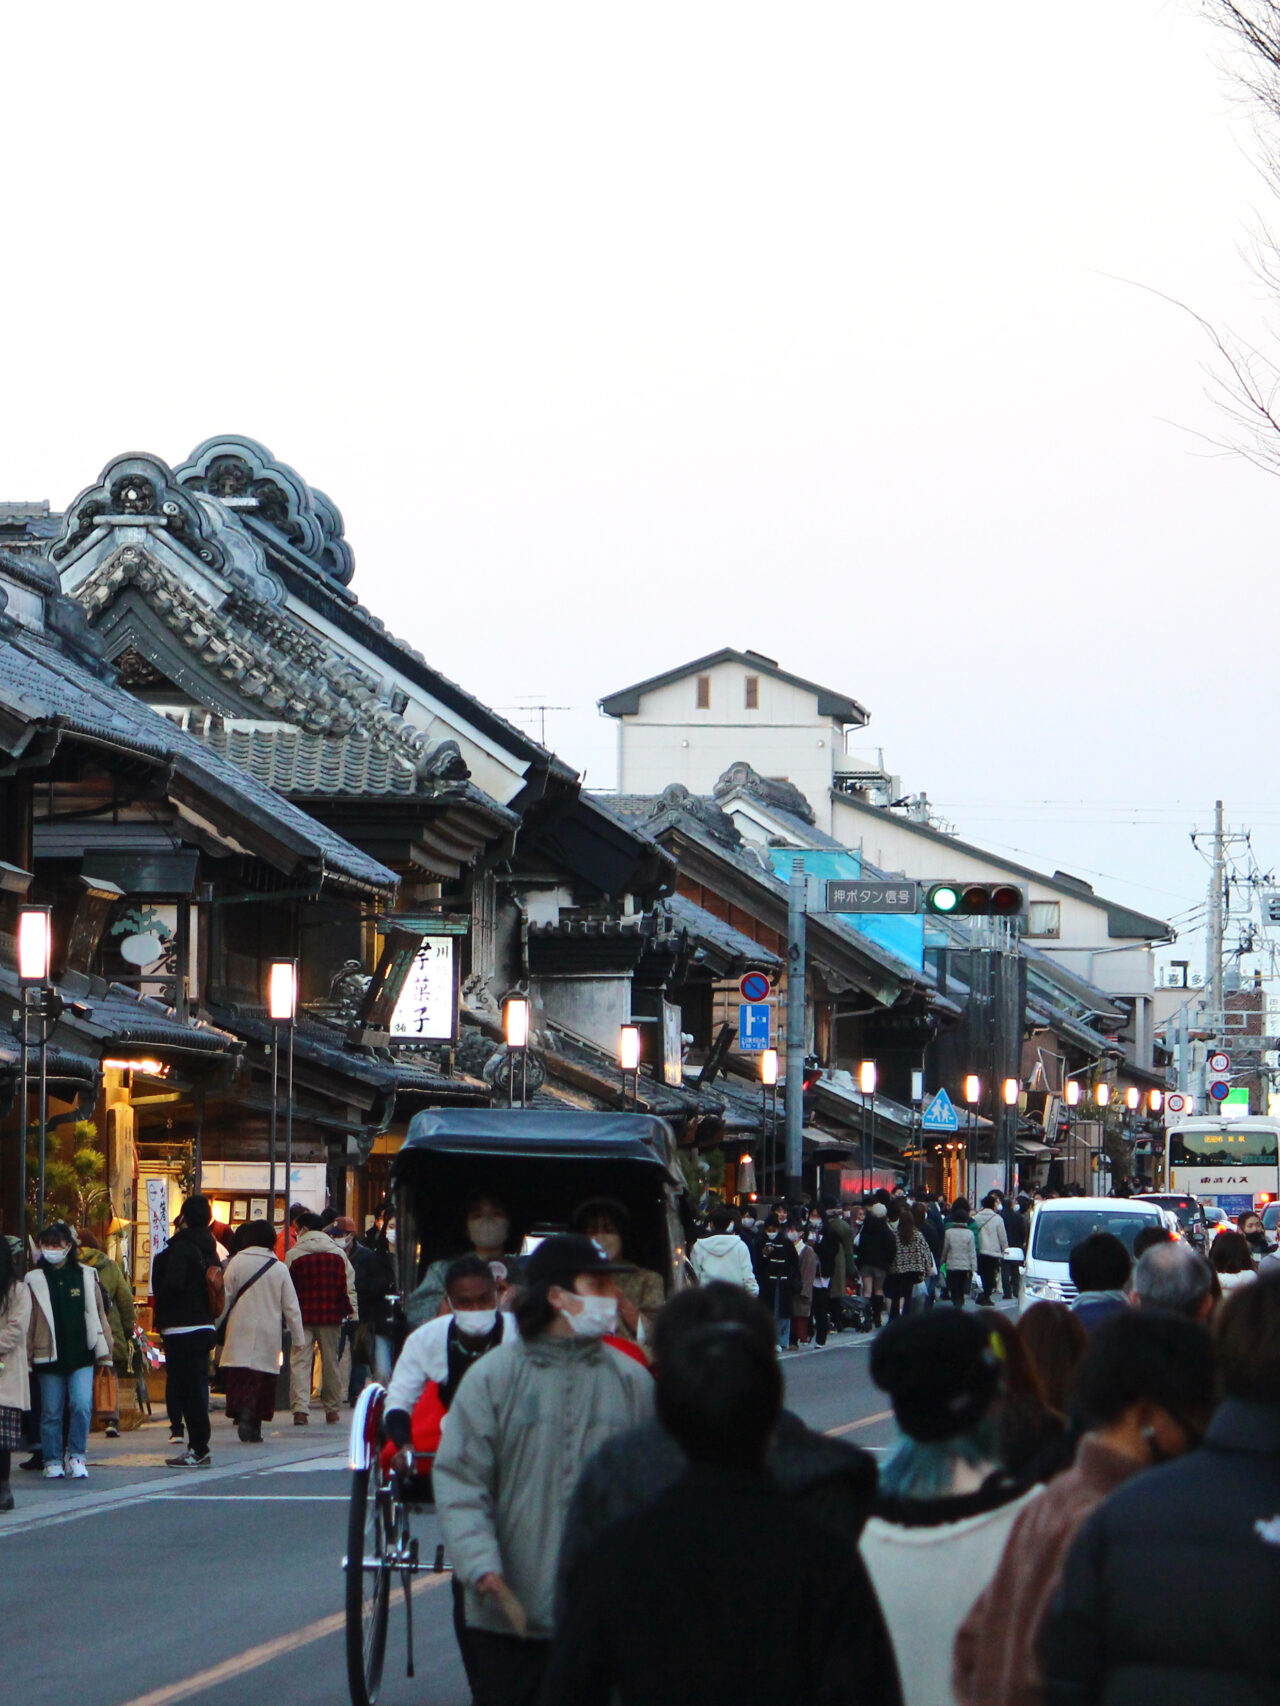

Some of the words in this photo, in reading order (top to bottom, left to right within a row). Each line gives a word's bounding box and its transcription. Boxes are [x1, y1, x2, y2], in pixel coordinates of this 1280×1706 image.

[833, 888, 910, 904] 押ボタン信号
[1214, 1056, 1225, 1068] 40
